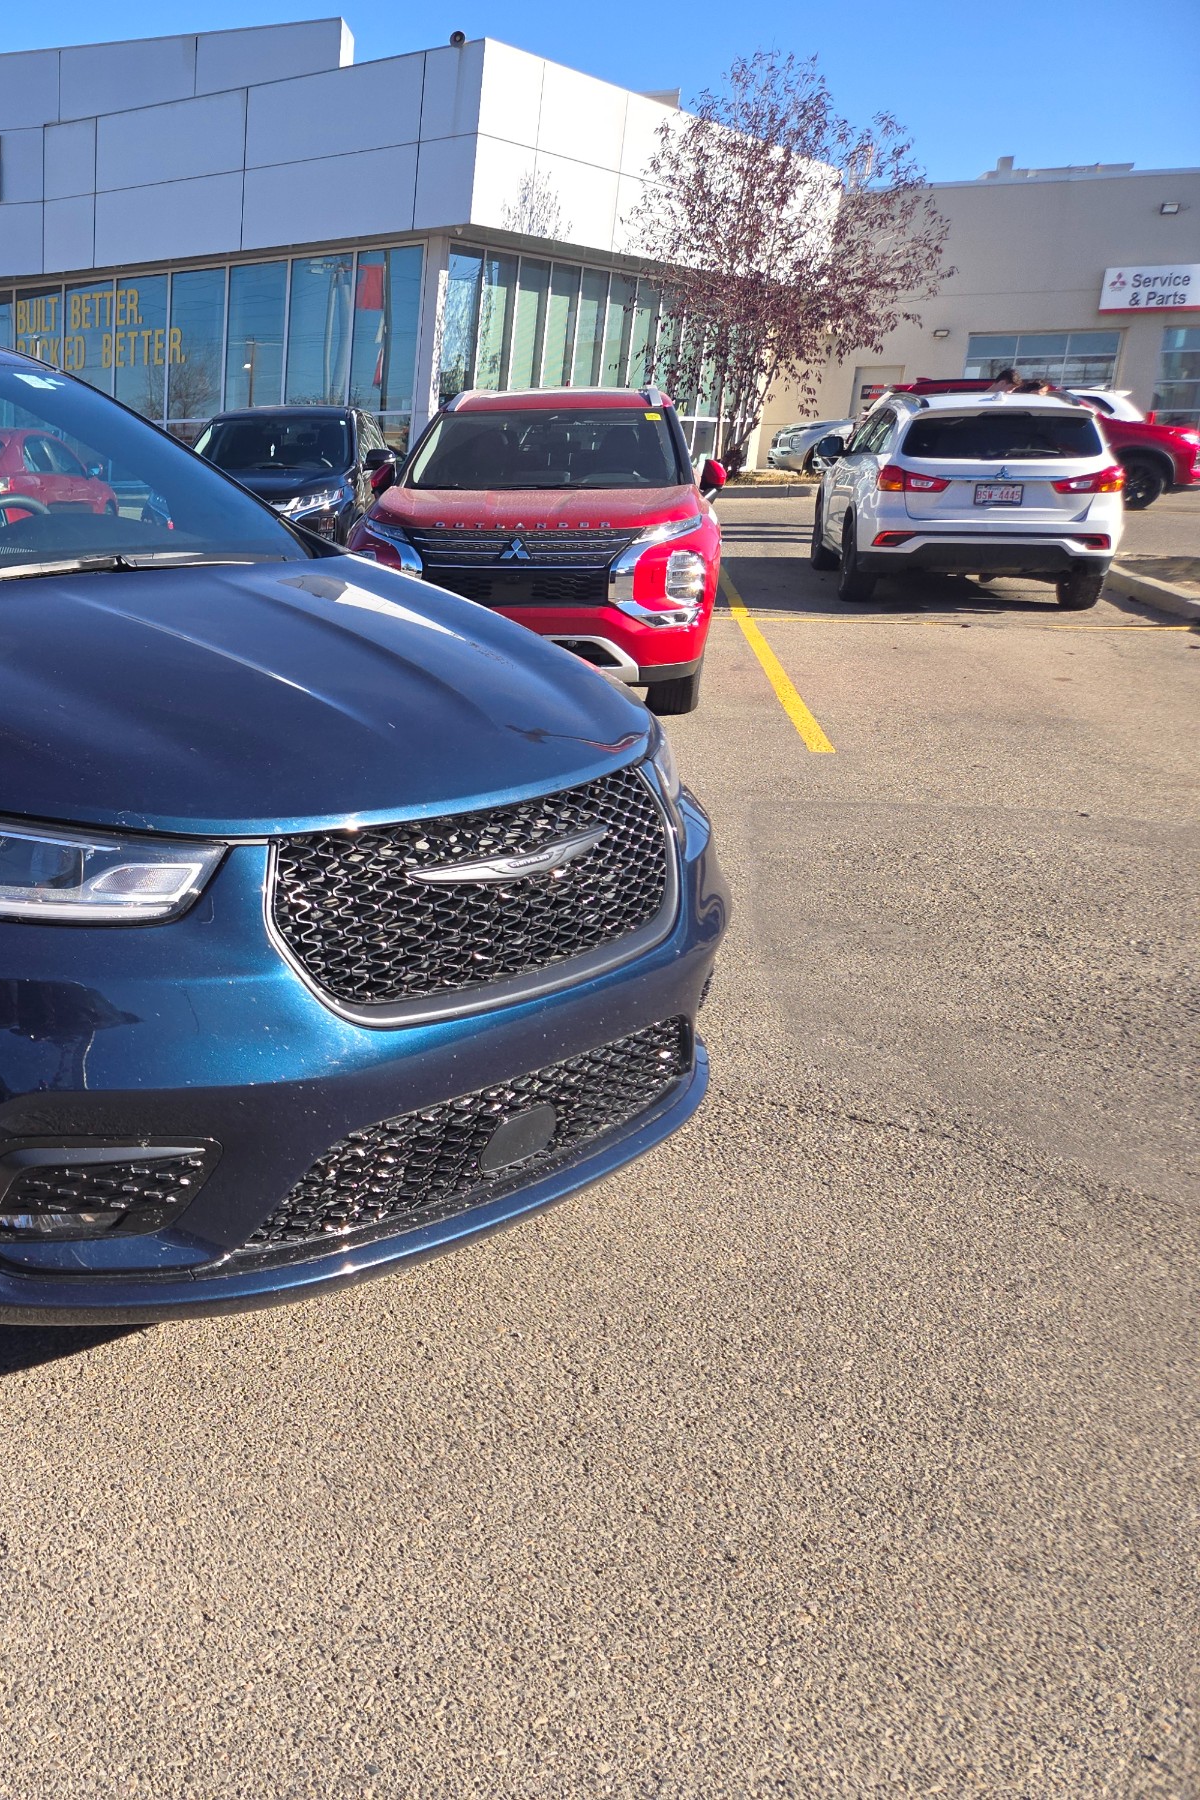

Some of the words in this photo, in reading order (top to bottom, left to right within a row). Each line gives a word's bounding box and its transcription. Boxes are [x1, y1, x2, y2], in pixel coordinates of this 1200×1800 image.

[1131, 272, 1191, 288] Service
[1129, 292, 1141, 306] &
[1145, 291, 1187, 306] Parts
[16, 297, 59, 335] BUILT
[71, 288, 144, 330] BETTER.
[102, 327, 186, 369] BETTER.
[433, 521, 612, 530] OUTLANDER
[509, 853, 551, 868] CHRYSLER
